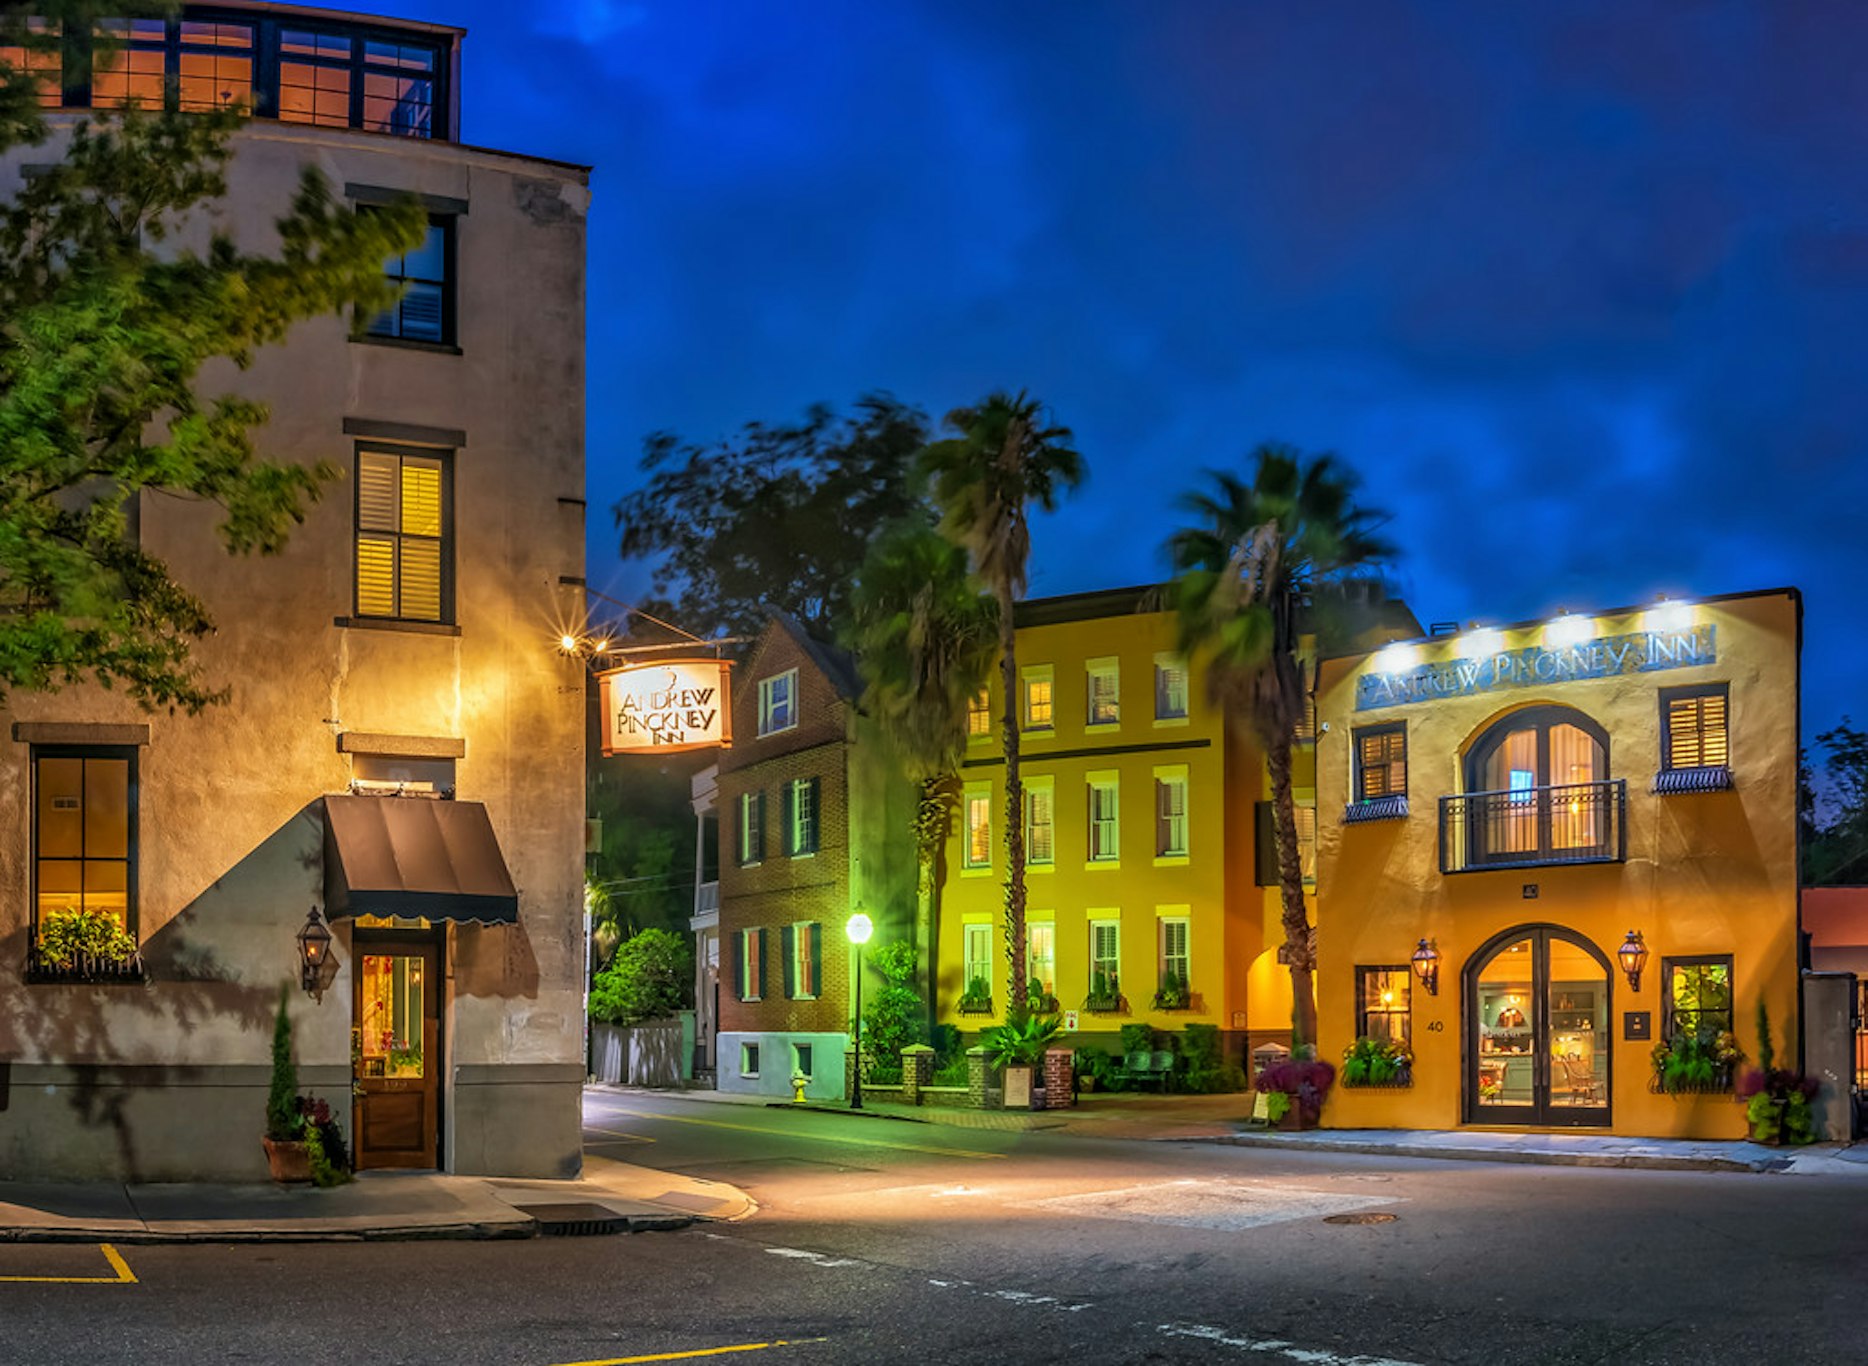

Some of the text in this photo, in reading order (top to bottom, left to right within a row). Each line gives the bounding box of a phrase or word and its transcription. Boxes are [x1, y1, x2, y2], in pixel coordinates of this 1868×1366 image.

[1371, 632, 1697, 703] ANDREW PINCKNEY INN
[621, 687, 715, 712] ANDREW
[617, 709, 717, 734] PINCKNEY
[652, 729, 685, 745] INN
[1427, 1020, 1444, 1033] 40
